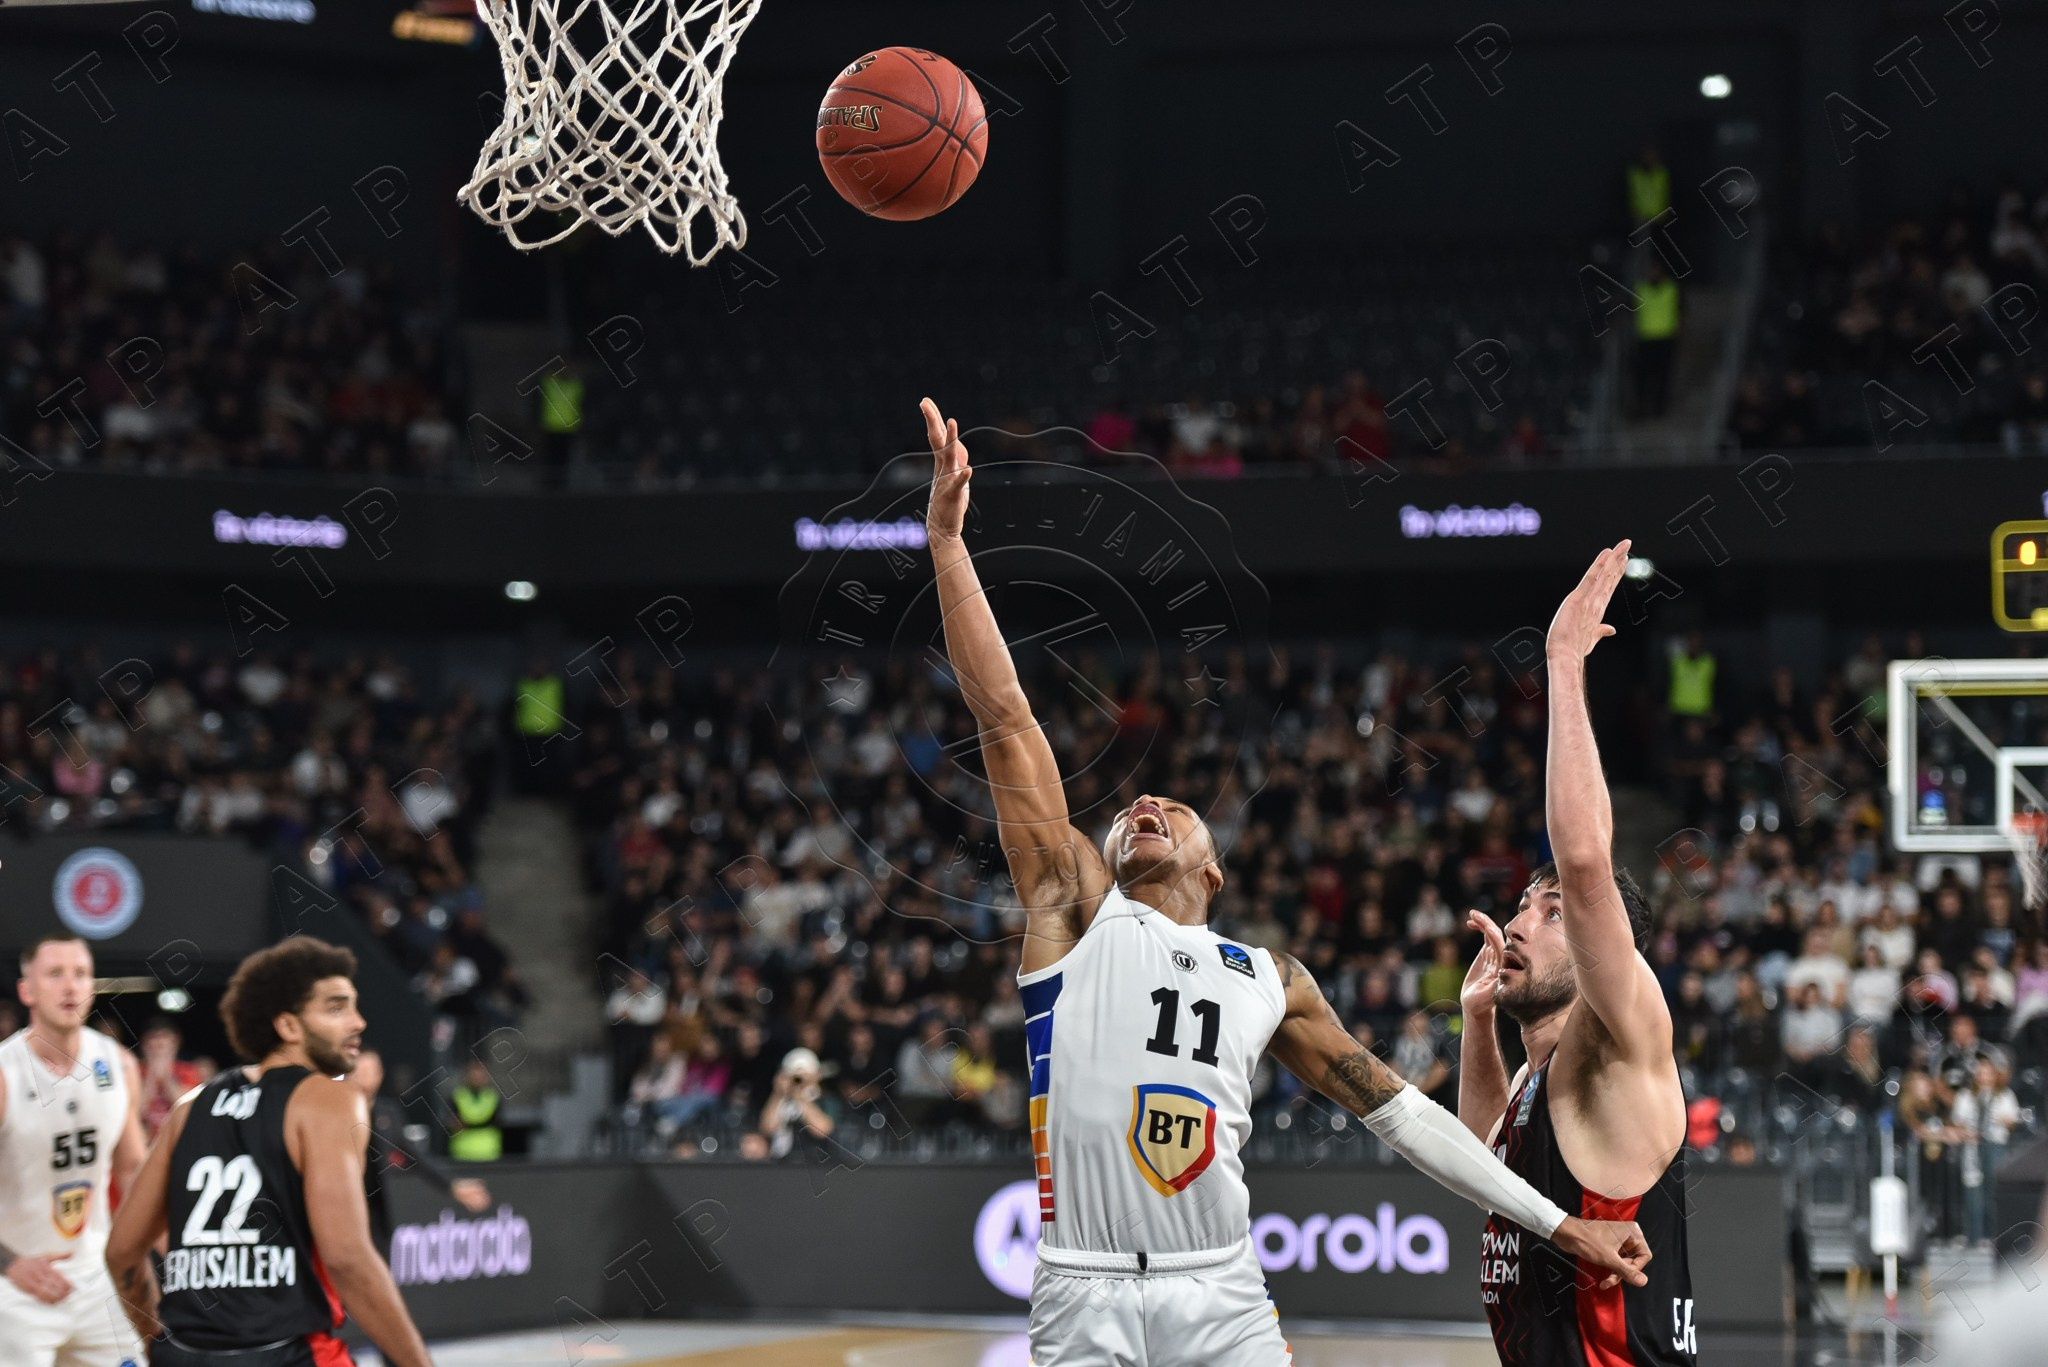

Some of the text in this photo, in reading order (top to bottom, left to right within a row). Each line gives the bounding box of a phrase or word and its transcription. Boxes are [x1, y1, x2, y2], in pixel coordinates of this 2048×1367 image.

[1146, 987, 1221, 1068] 11
[52, 1126, 97, 1170] 55
[1148, 1109, 1202, 1149] BT
[182, 1155, 262, 1246] 22
[1250, 1202, 1449, 1274] orola
